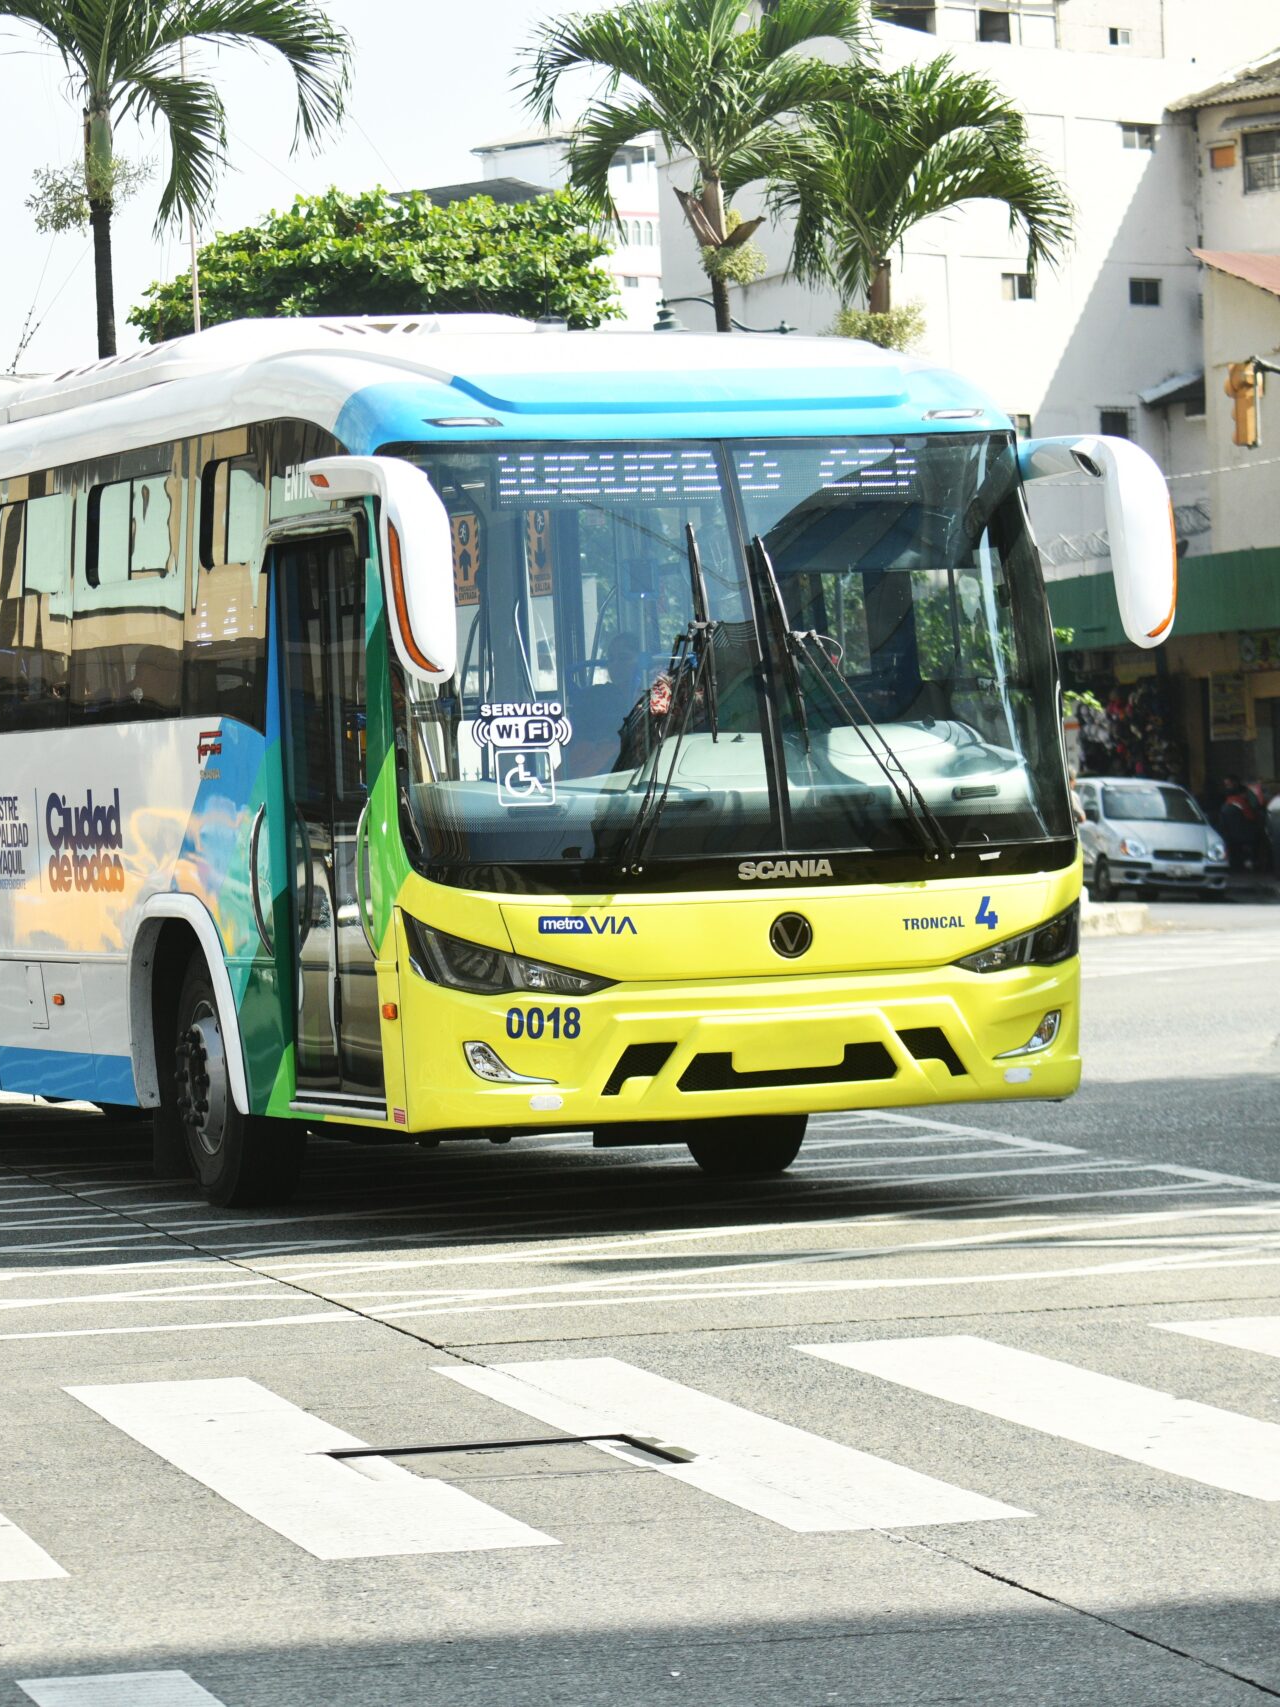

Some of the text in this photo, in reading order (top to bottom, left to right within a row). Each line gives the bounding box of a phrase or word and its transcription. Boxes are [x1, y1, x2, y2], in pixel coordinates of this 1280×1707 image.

[480, 702, 562, 717] SERVICIO
[46, 787, 123, 852] Ciudad
[48, 848, 125, 893] de todos
[738, 859, 834, 880] SCANIA
[902, 895, 999, 931] TRONCAL 4
[505, 1006, 582, 1040] 0018
